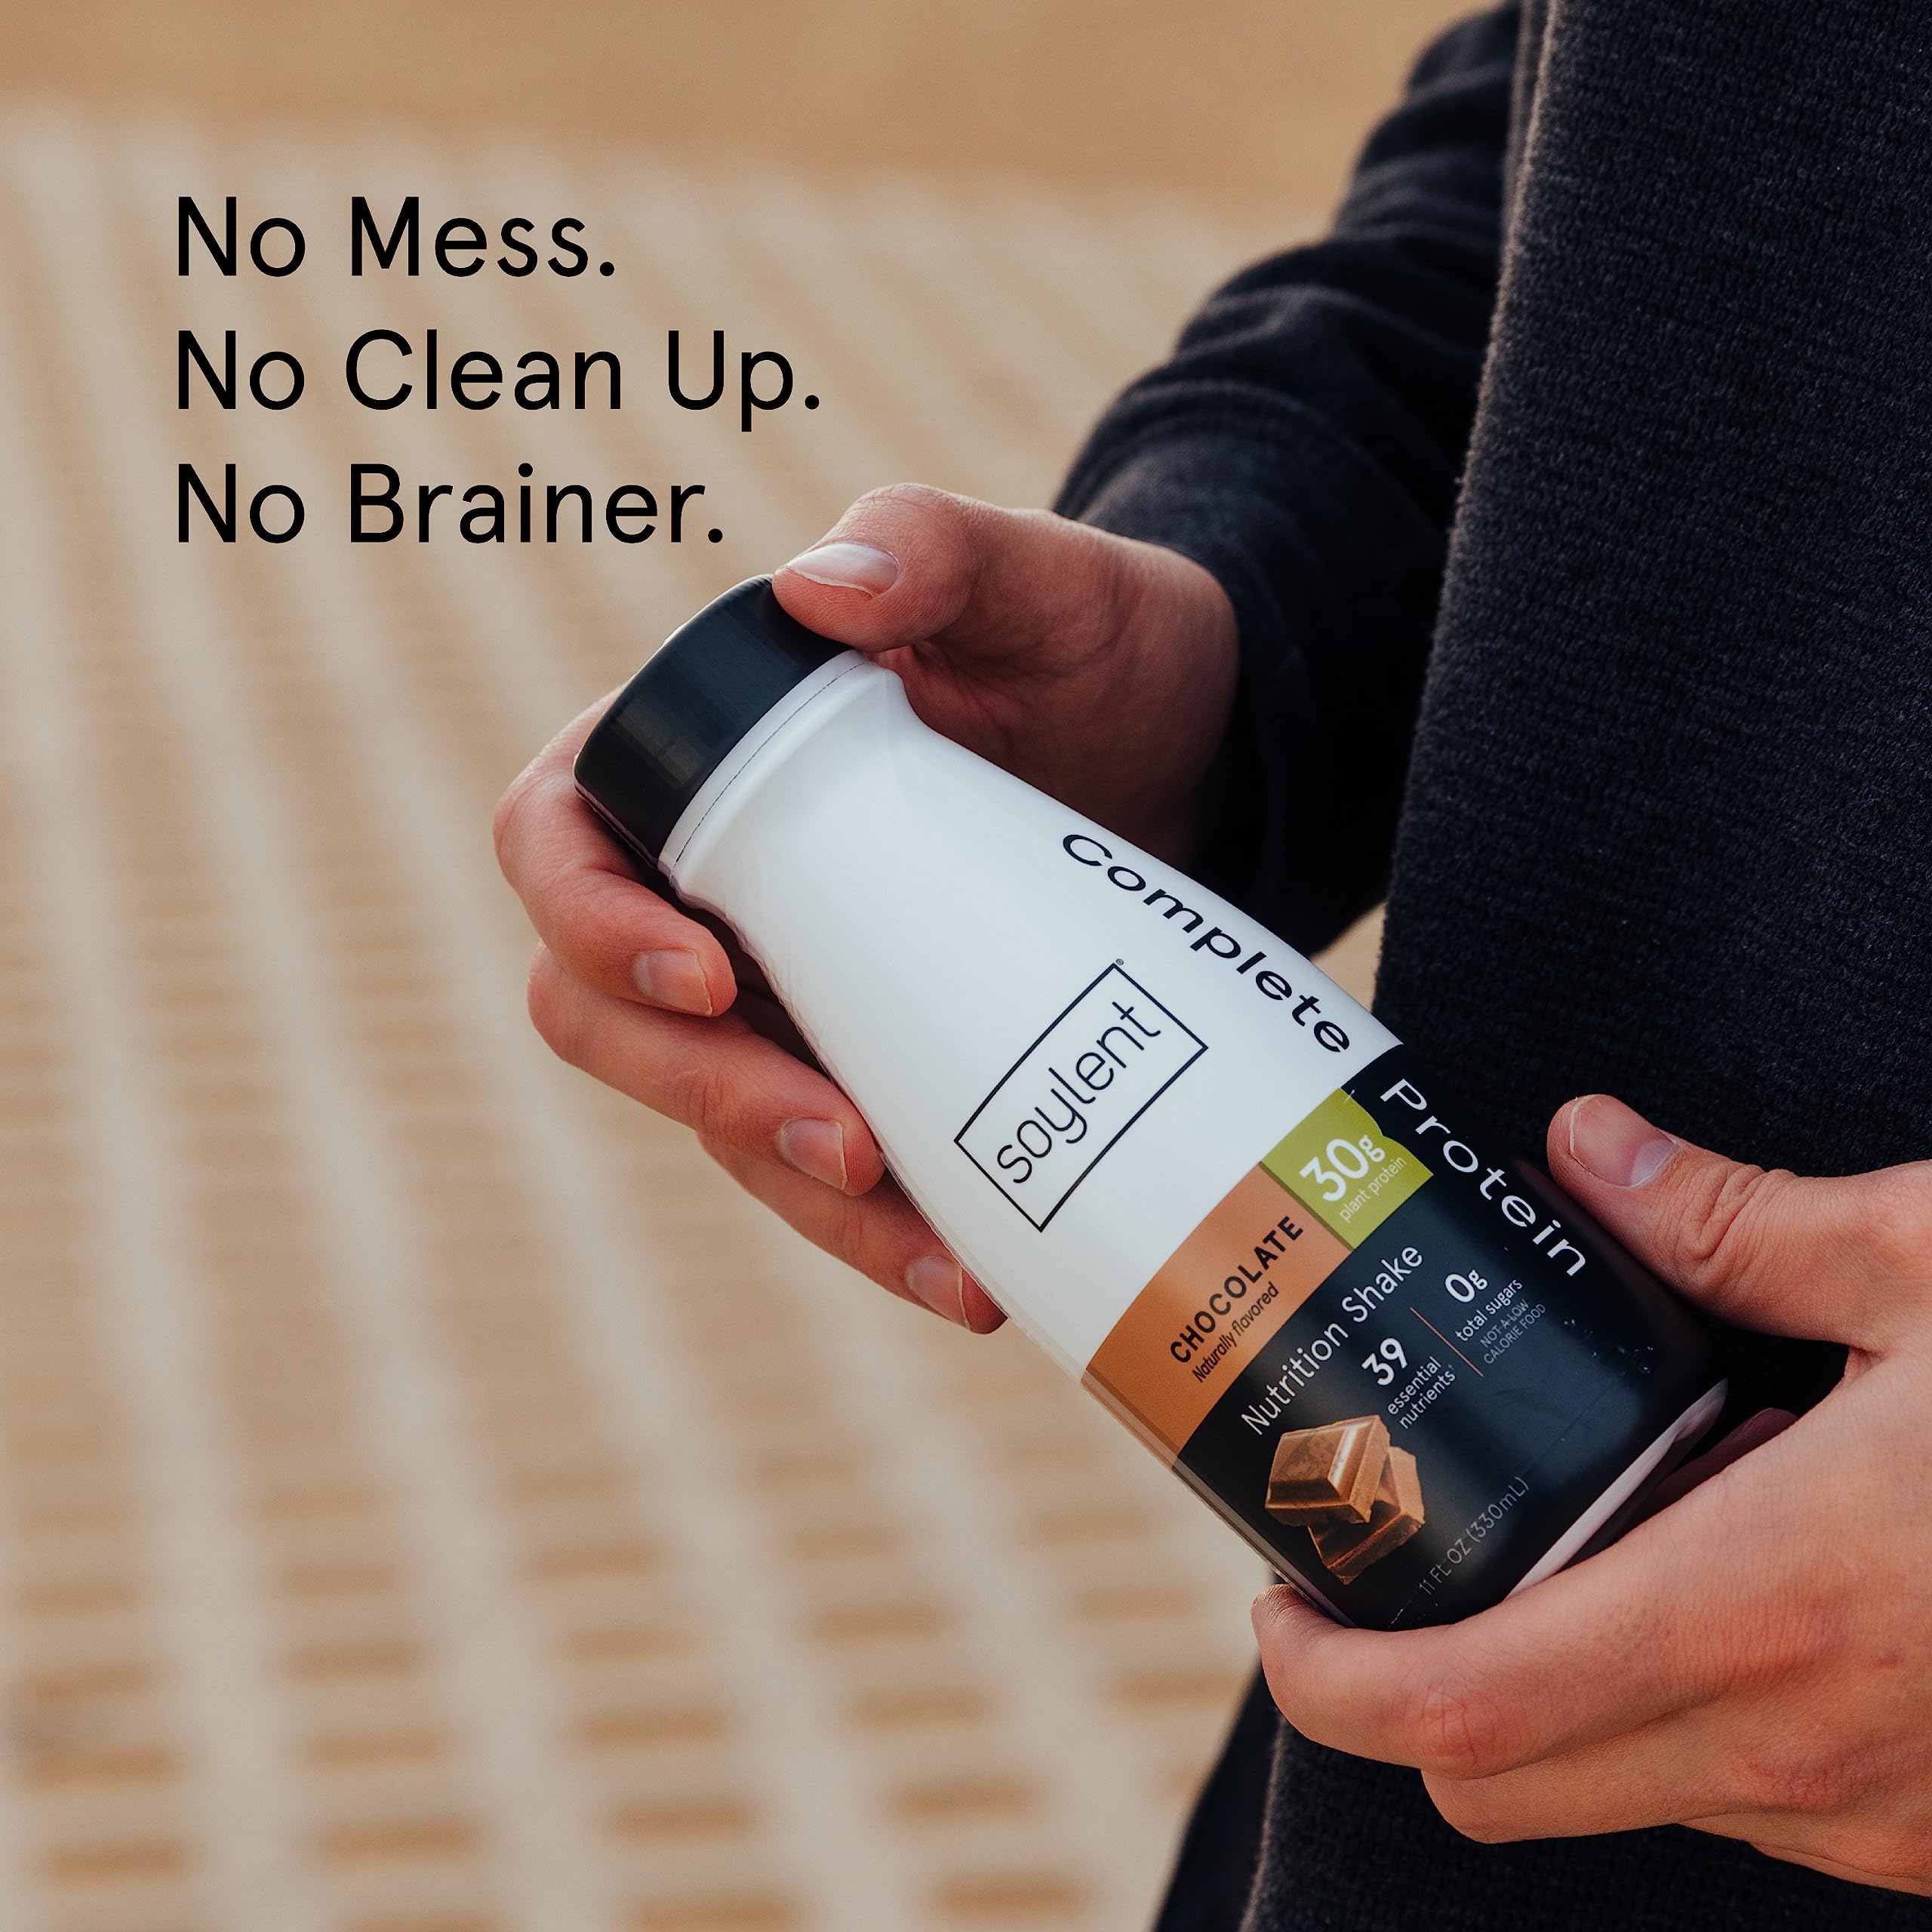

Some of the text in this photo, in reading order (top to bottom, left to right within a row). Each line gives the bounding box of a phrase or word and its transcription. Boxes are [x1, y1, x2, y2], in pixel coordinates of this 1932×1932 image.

[1063, 833, 1587, 1277] Complete Protein
[996, 1001, 1161, 1183] soylent
[1298, 1134, 1386, 1201] 30g
[1340, 1156, 1407, 1223] plant protein
[1170, 1216, 1303, 1363] CHOCOLATE
[1444, 1269, 1488, 1303] 0g
[1455, 1279, 1523, 1342] total sugars
[1192, 1281, 1279, 1383] Naturally flavored
[1241, 1246, 1423, 1435] Nutrition Shake
[1480, 1298, 1530, 1348] NOT A LOW
[1483, 1303, 1546, 1364] CALORIE FOOD
[1361, 1337, 1408, 1386] 39
[1387, 1355, 1441, 1415] essential
[1419, 1579, 1435, 1595] 11
[1447, 1538, 1472, 1564] OZ
[1466, 1476, 1529, 1543] (330mL)
